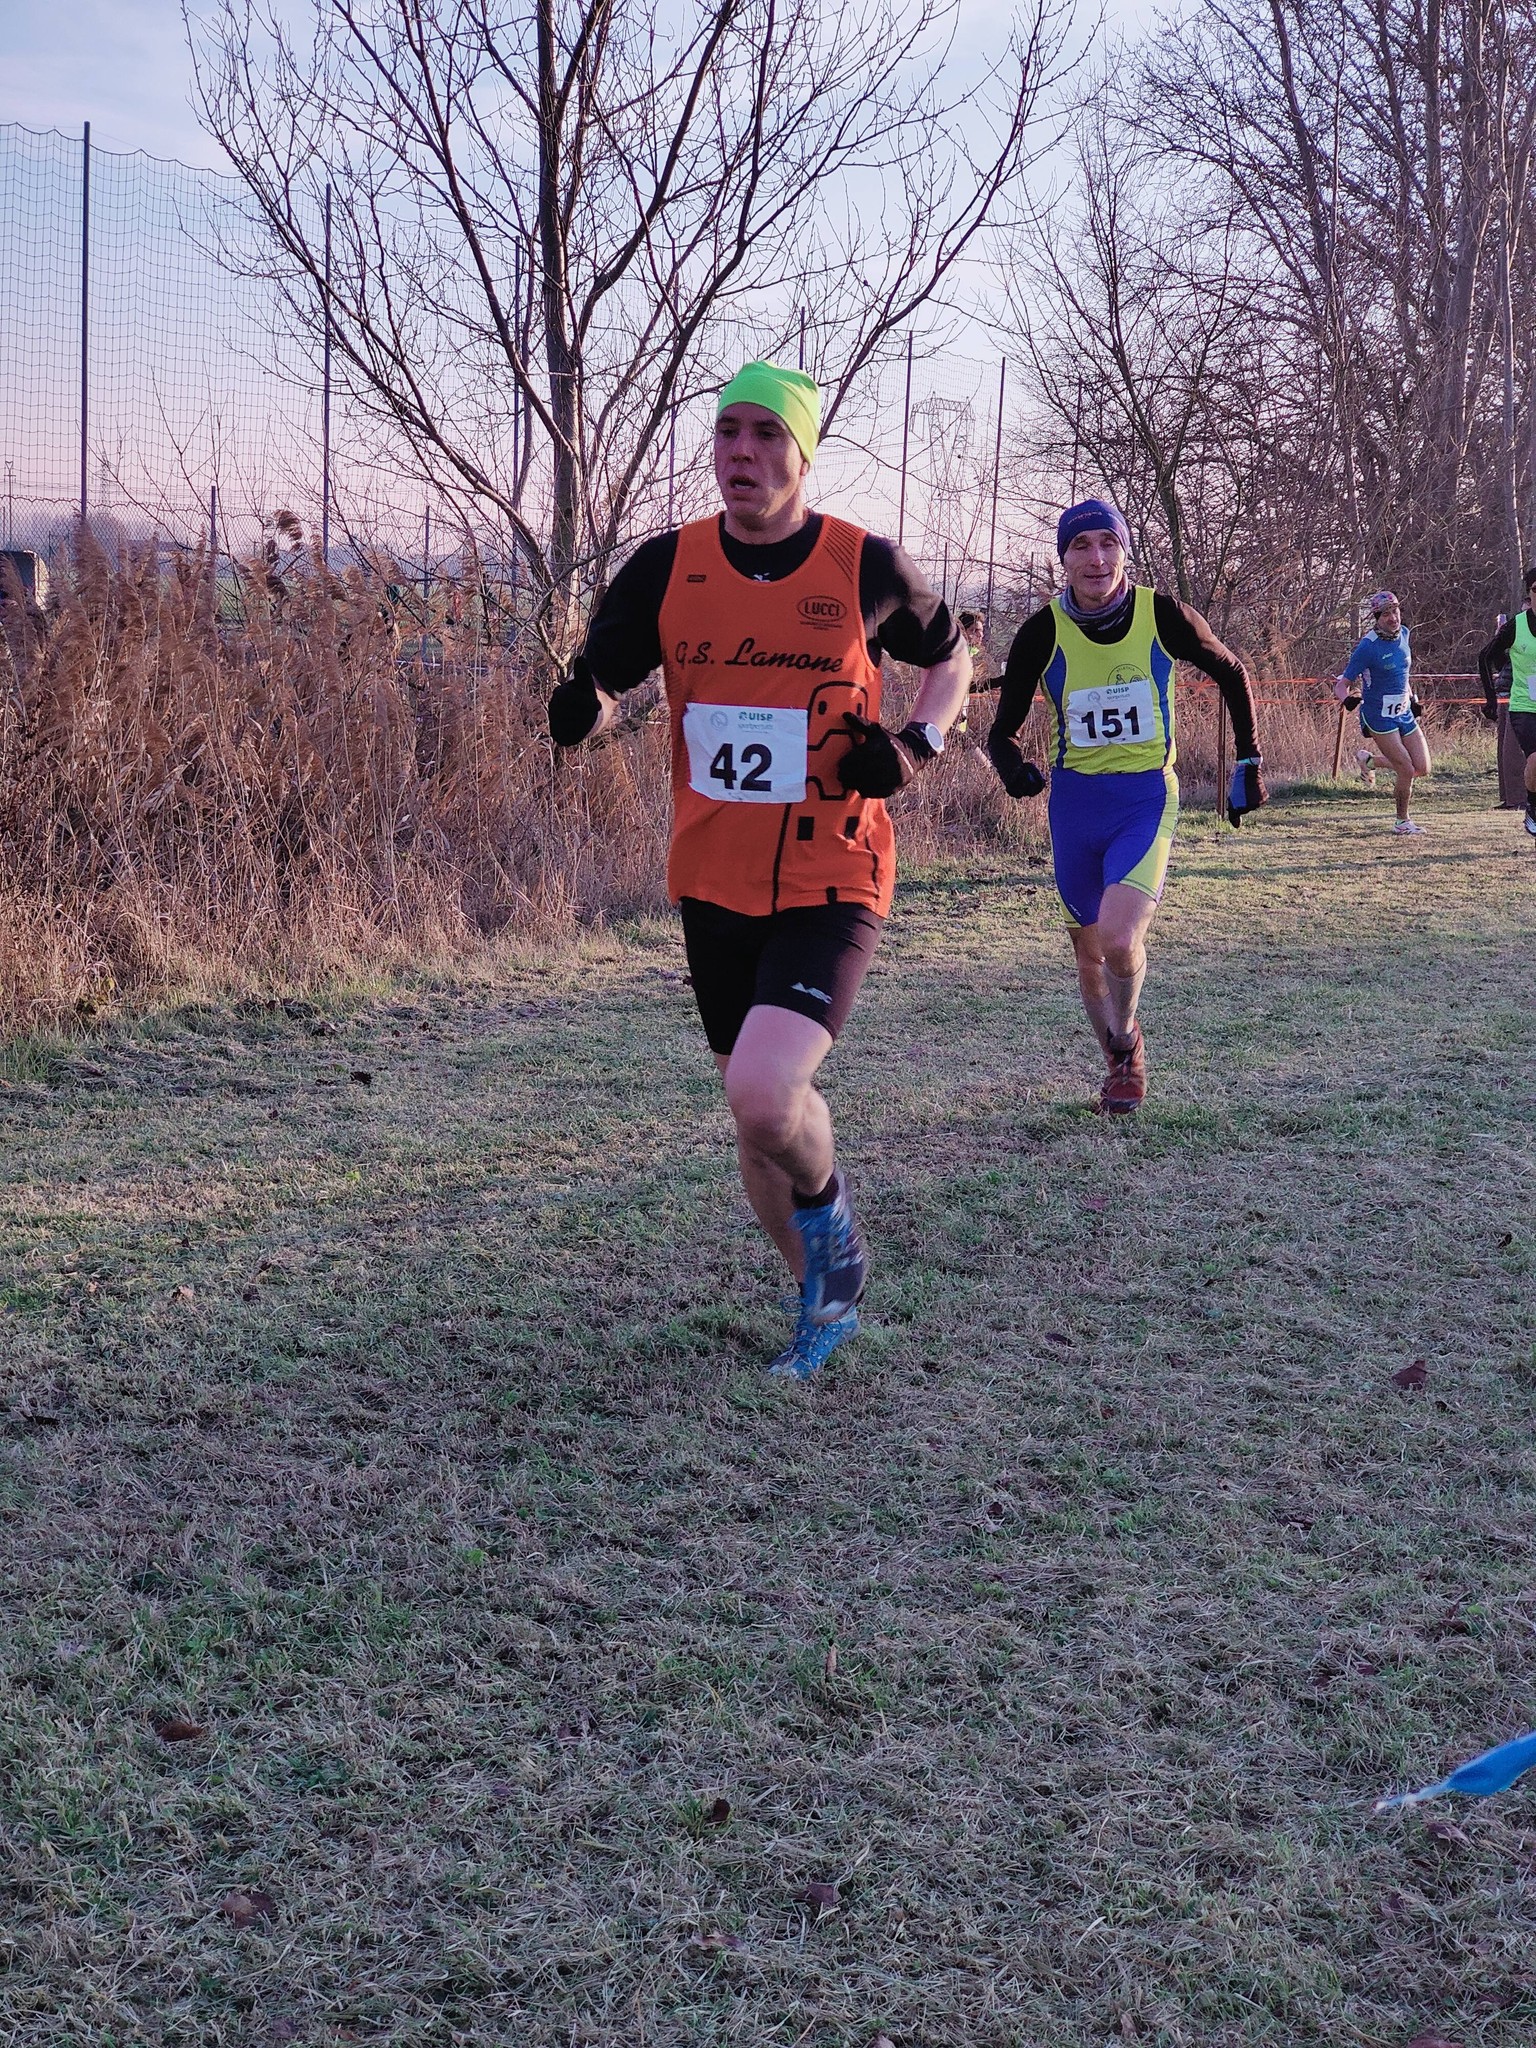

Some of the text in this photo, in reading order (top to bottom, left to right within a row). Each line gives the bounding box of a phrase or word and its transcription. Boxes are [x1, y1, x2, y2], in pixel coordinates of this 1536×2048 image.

[804, 601, 840, 617] LUCCI
[675, 637, 843, 673] G.S. Lamone
[749, 712, 773, 721] UISP
[1081, 706, 1140, 739] 151
[710, 743, 772, 792] 42
